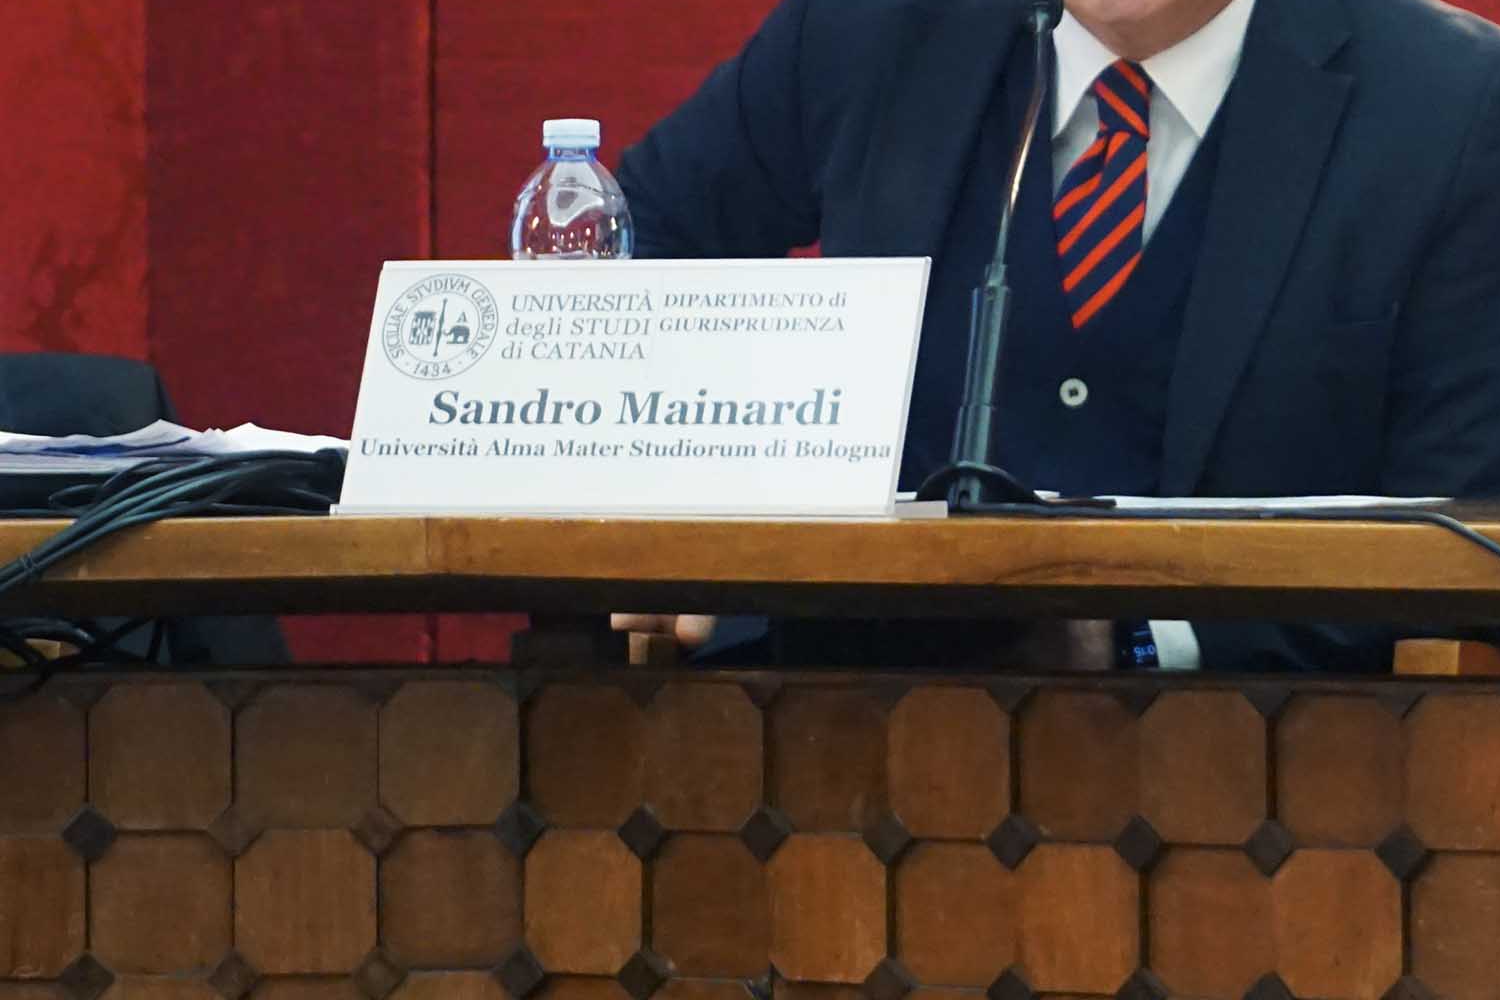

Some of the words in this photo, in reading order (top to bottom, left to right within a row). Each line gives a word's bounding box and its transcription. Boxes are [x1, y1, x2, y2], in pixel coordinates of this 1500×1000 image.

[511, 288, 654, 313] UNIVERSITÀ
[663, 292, 824, 308] DIPARTIMENTO
[828, 291, 848, 308] di
[505, 317, 562, 341] degli
[570, 317, 652, 336] STUDI
[658, 317, 846, 333] GIURISPRUDENZA
[500, 340, 523, 360] di
[530, 341, 648, 360] CATANIA
[428, 388, 602, 426] Sandro
[613, 388, 843, 427] Mainardi
[360, 437, 478, 457] Università
[484, 438, 546, 457] Alma
[552, 439, 624, 457] Mater
[629, 438, 756, 458] Studiorum
[764, 439, 787, 458] di
[795, 439, 891, 463] Bologna
